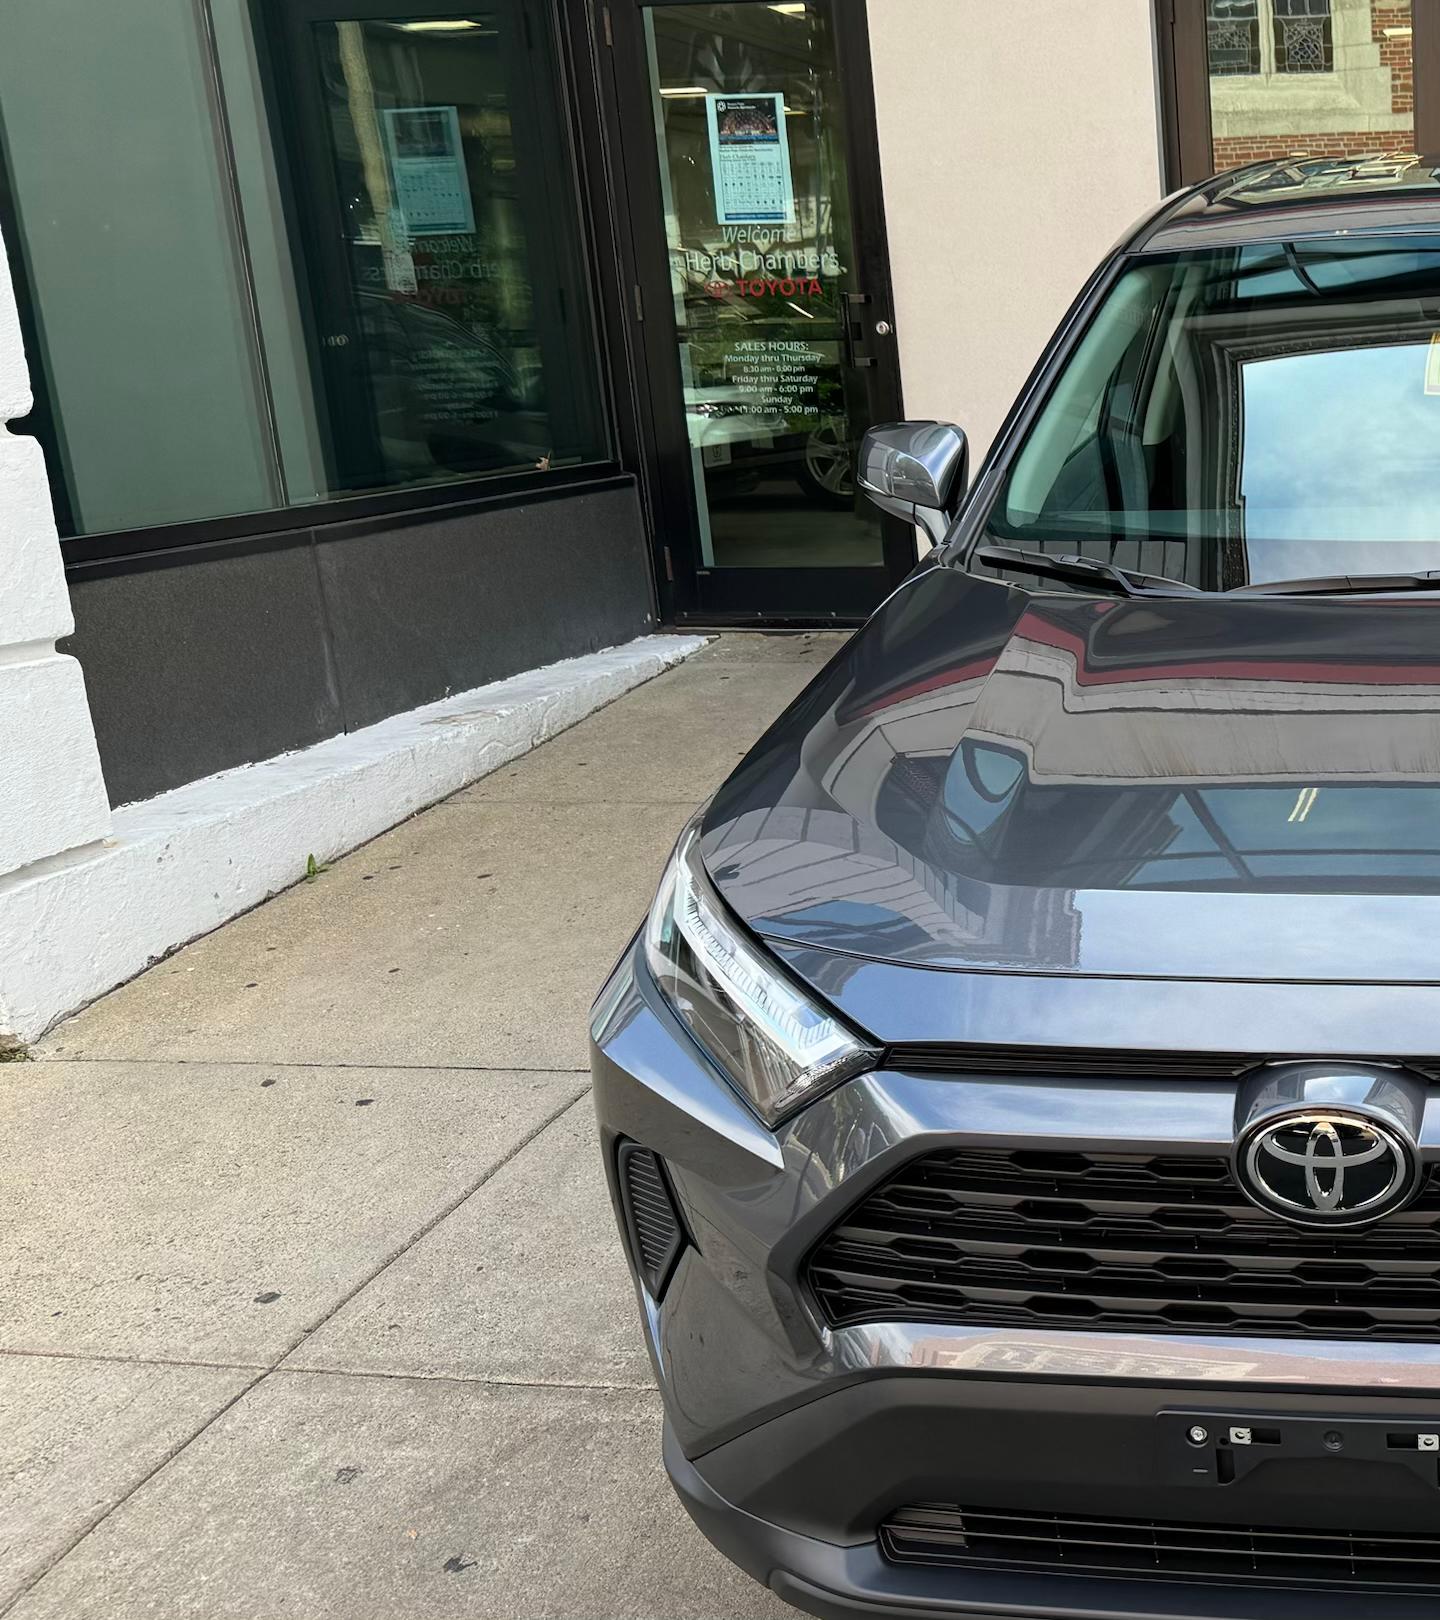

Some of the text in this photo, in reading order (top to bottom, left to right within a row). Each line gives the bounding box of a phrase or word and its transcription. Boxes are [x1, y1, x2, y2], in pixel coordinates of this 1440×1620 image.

[722, 226, 797, 243] Welcome
[685, 249, 840, 272] Herb Chambers
[736, 278, 823, 298] TOYOTA
[734, 341, 809, 351] SALES HOURS:
[724, 353, 822, 364] Monday thru Thursday
[793, 366, 805, 374] pm
[732, 374, 818, 385] Friday thru Saturday
[779, 385, 798, 393] 6:00
[799, 386, 813, 395] pm
[761, 395, 793, 405] Sunday
[784, 405, 803, 413] 5:00
[804, 406, 818, 415] pm
